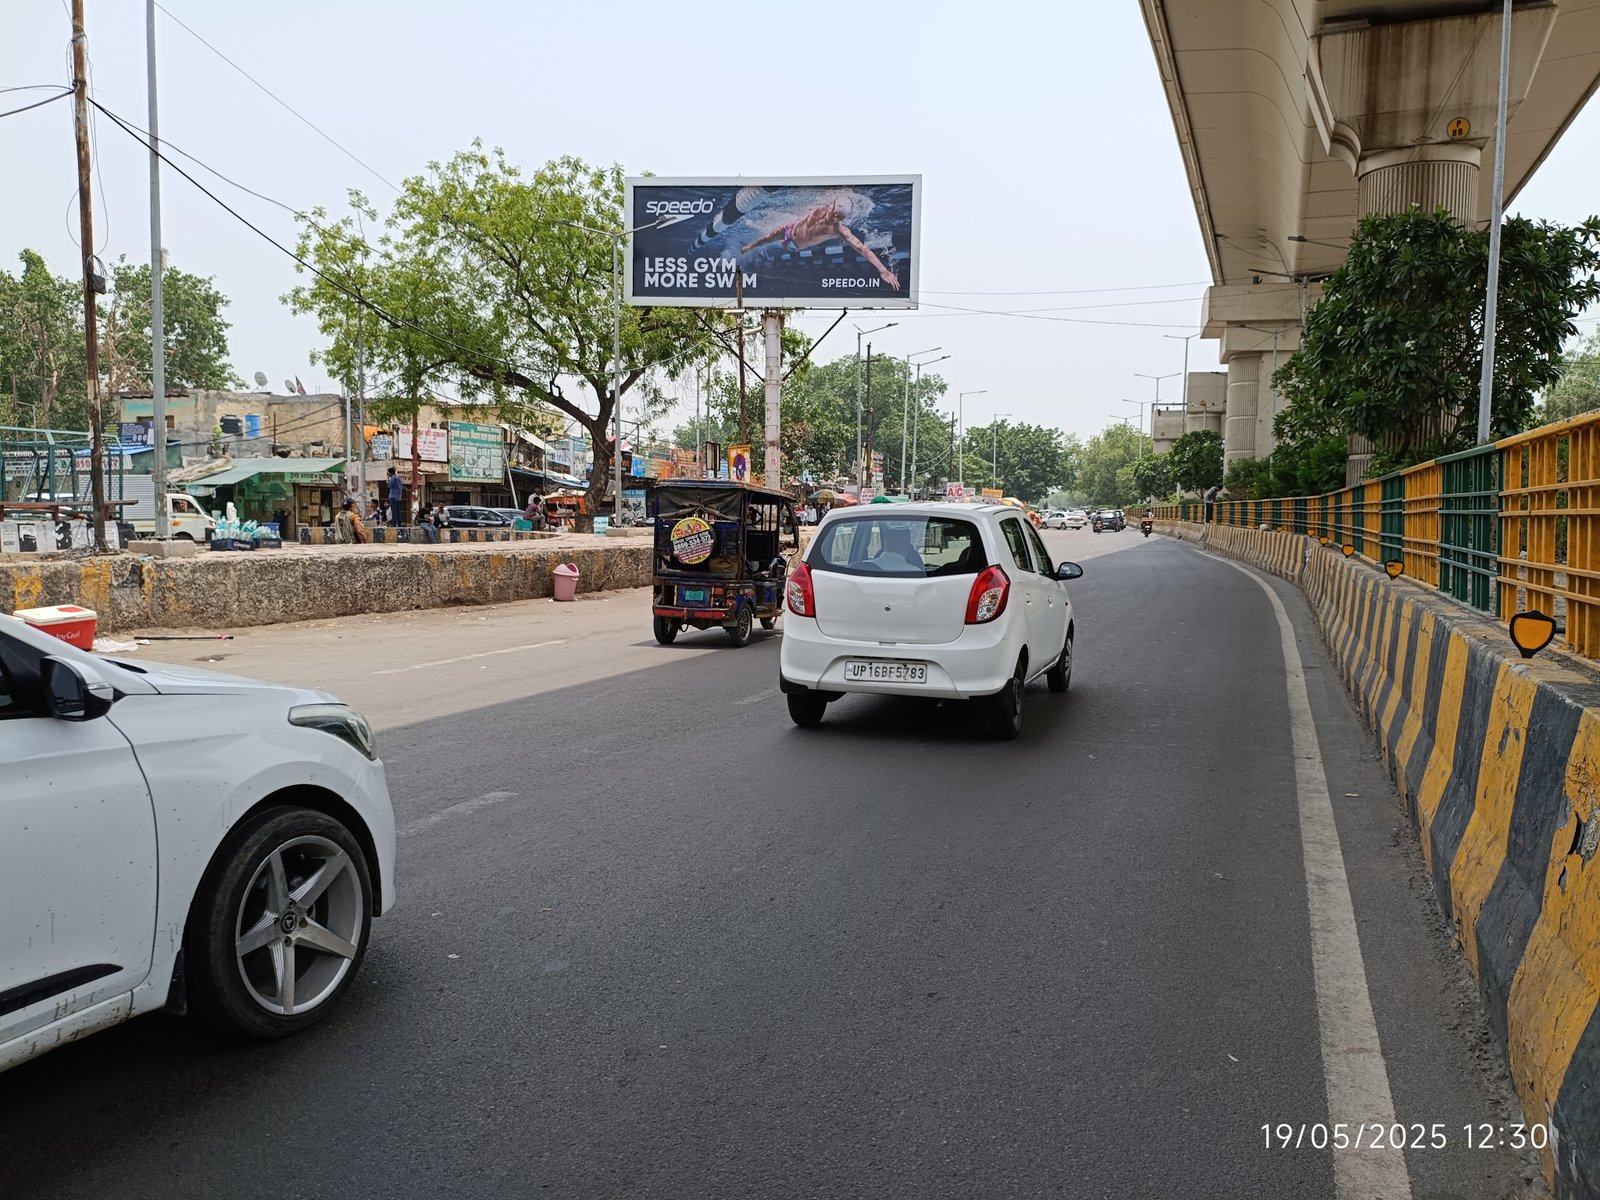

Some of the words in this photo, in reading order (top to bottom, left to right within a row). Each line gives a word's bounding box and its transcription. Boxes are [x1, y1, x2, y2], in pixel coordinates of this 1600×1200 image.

[645, 198, 715, 216] speedo
[644, 257, 688, 273] LESS
[693, 257, 737, 273] GYM
[644, 273, 699, 289] MORE
[704, 273, 757, 289] SWM
[821, 277, 880, 289] SPEEDO.IN
[947, 487, 963, 497] A/C
[853, 665, 925, 679] UP16BF5783
